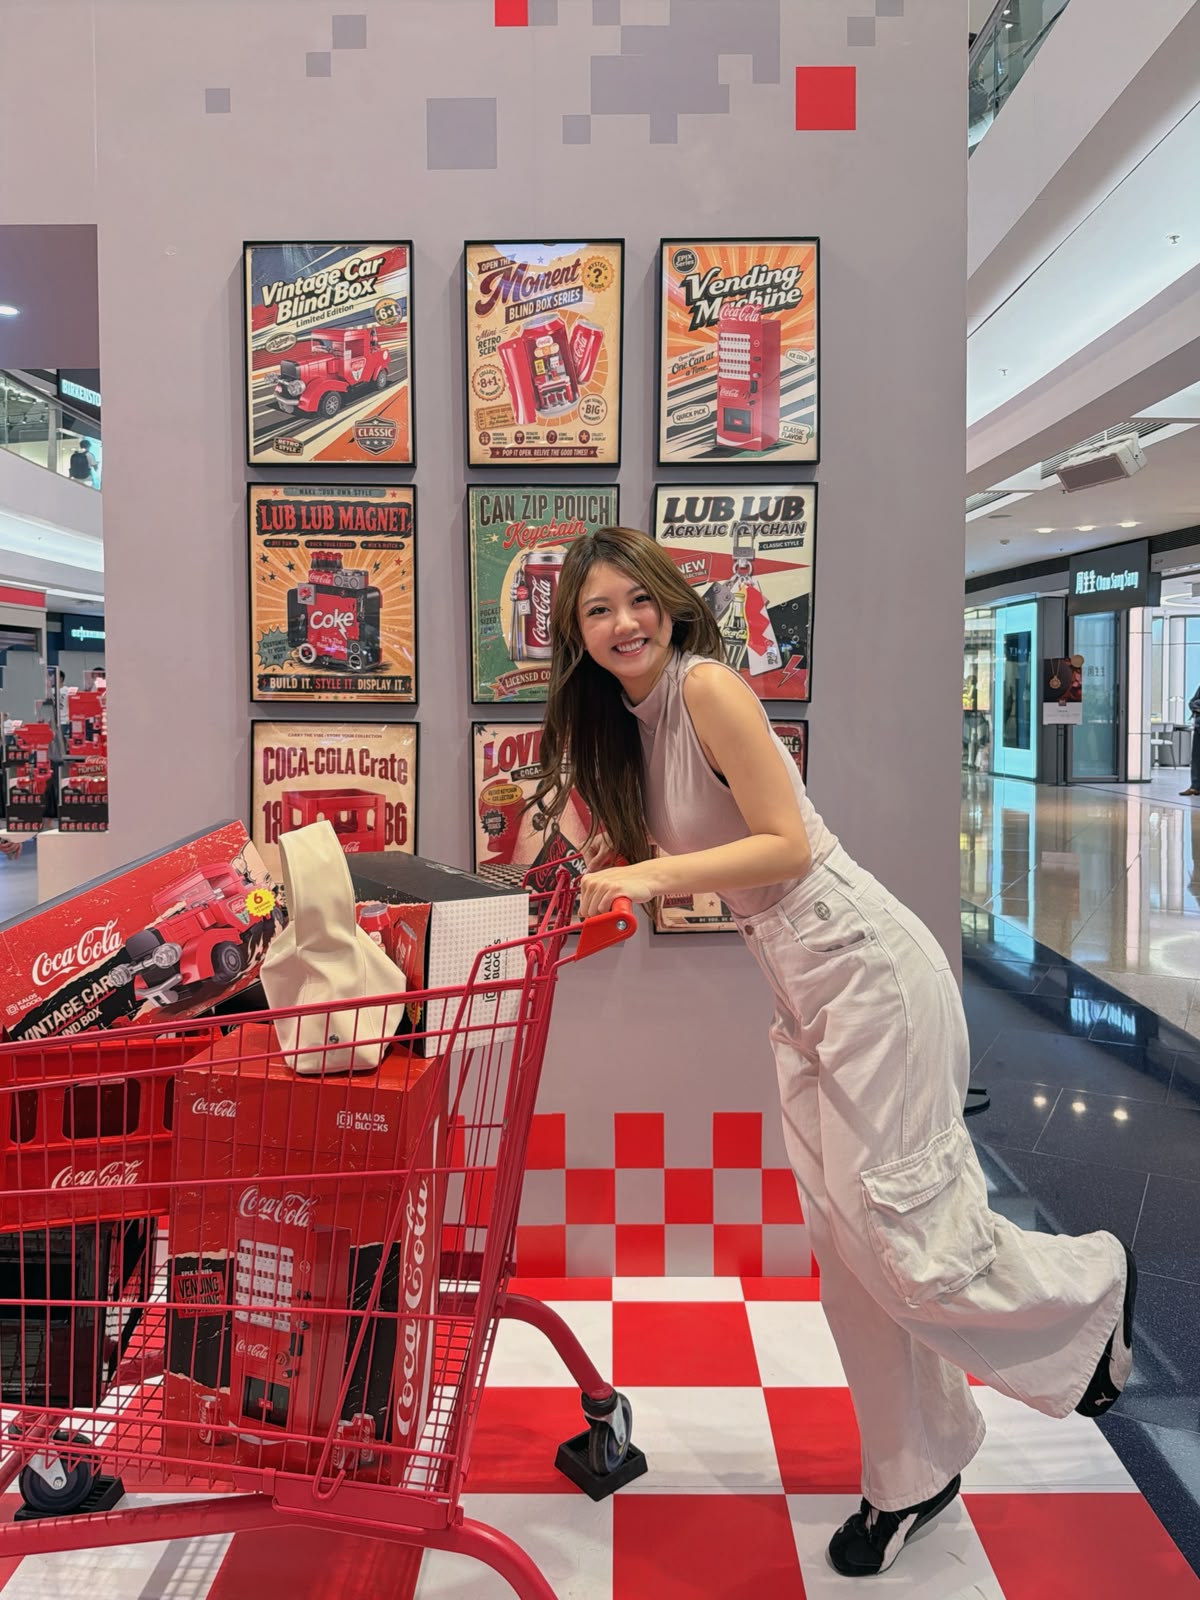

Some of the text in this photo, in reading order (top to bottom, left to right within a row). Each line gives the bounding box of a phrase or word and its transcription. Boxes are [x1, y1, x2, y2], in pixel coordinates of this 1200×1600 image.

[481, 262, 499, 272] OPEN
[262, 258, 385, 307] Vintage Car
[475, 258, 581, 316] Moment
[686, 266, 802, 300] Vending
[277, 278, 376, 324] Blind Box
[508, 288, 580, 320] BLIND BOX SERIES
[296, 304, 354, 328] Limited Edition
[719, 304, 760, 322] Coca-Cola
[475, 328, 497, 341] Mini
[478, 336, 501, 349] RETRO
[479, 345, 497, 357] SCEN
[672, 351, 714, 374] One Can at
[480, 376, 498, 388] 8+1
[586, 404, 600, 414] BIG
[676, 408, 706, 421] QUICK PICK
[358, 428, 393, 437] CLASSIC
[781, 431, 802, 441] FLAVOR
[783, 426, 805, 435] CLASSIC
[261, 504, 408, 531] LUB LUB MAGNET
[480, 495, 609, 526] CAN ZIP POUCH
[663, 495, 805, 524] LUB LUB
[503, 516, 587, 549] Keychain
[663, 523, 727, 537] ACRYLIC
[762, 542, 783, 550] CLASSIC
[677, 559, 705, 574] NEW
[310, 610, 354, 629] Coke
[532, 576, 551, 646] Coca-Cola
[270, 677, 405, 690] BUILD IT. STYLE IT. DISPLAY IT.
[505, 674, 538, 686] LICENSED
[784, 744, 800, 753] YLE
[263, 747, 408, 785] COCA-COLA Crate
[262, 801, 407, 845] 18 86
[253, 892, 264, 904] 6
[32, 917, 123, 987] Coca-Cola
[492, 938, 501, 979] BLOCS
[80, 972, 114, 1005] CAR
[17, 993, 37, 1004] KALOS
[20, 997, 43, 1011] BLOCKS
[80, 1006, 103, 1029] BOX
[192, 1097, 241, 1118] Coca-Cola
[355, 1112, 386, 1123] KALOS
[355, 1122, 389, 1132] BLOCKS
[51, 1160, 144, 1189] Coca-Cola
[239, 1185, 322, 1228] Coca-Cola
[396, 1176, 429, 1436] Coca-Cola
